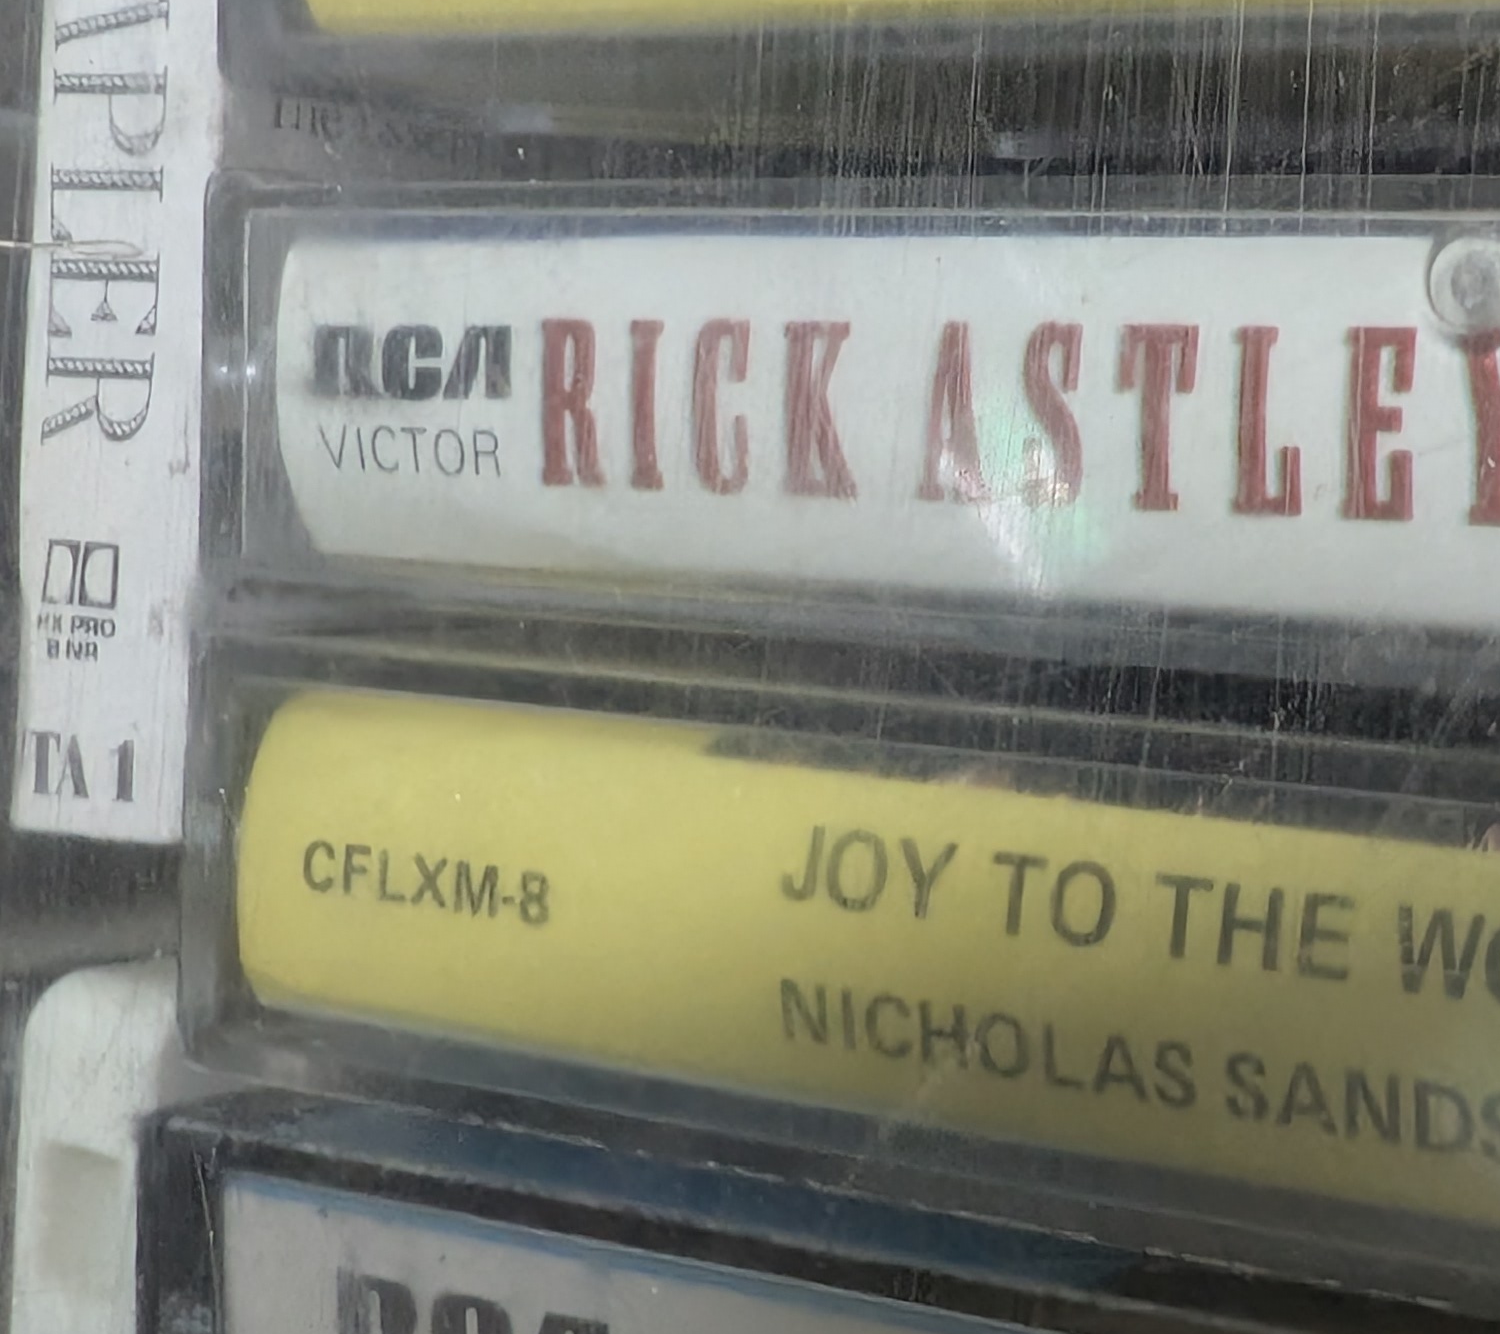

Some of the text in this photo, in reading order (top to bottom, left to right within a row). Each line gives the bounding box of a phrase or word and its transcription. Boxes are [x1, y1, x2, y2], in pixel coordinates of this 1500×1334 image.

[312, 324, 514, 401] RCA
[318, 425, 502, 478] VICTOR
[540, 318, 858, 501] RICK
[71, 615, 116, 639] PRO
[303, 839, 550, 926] CFLXM-8
[781, 824, 959, 919] JOY
[993, 850, 1117, 948] TO
[1155, 872, 1354, 983] THE
[779, 976, 1197, 1110] NICHOLAS
